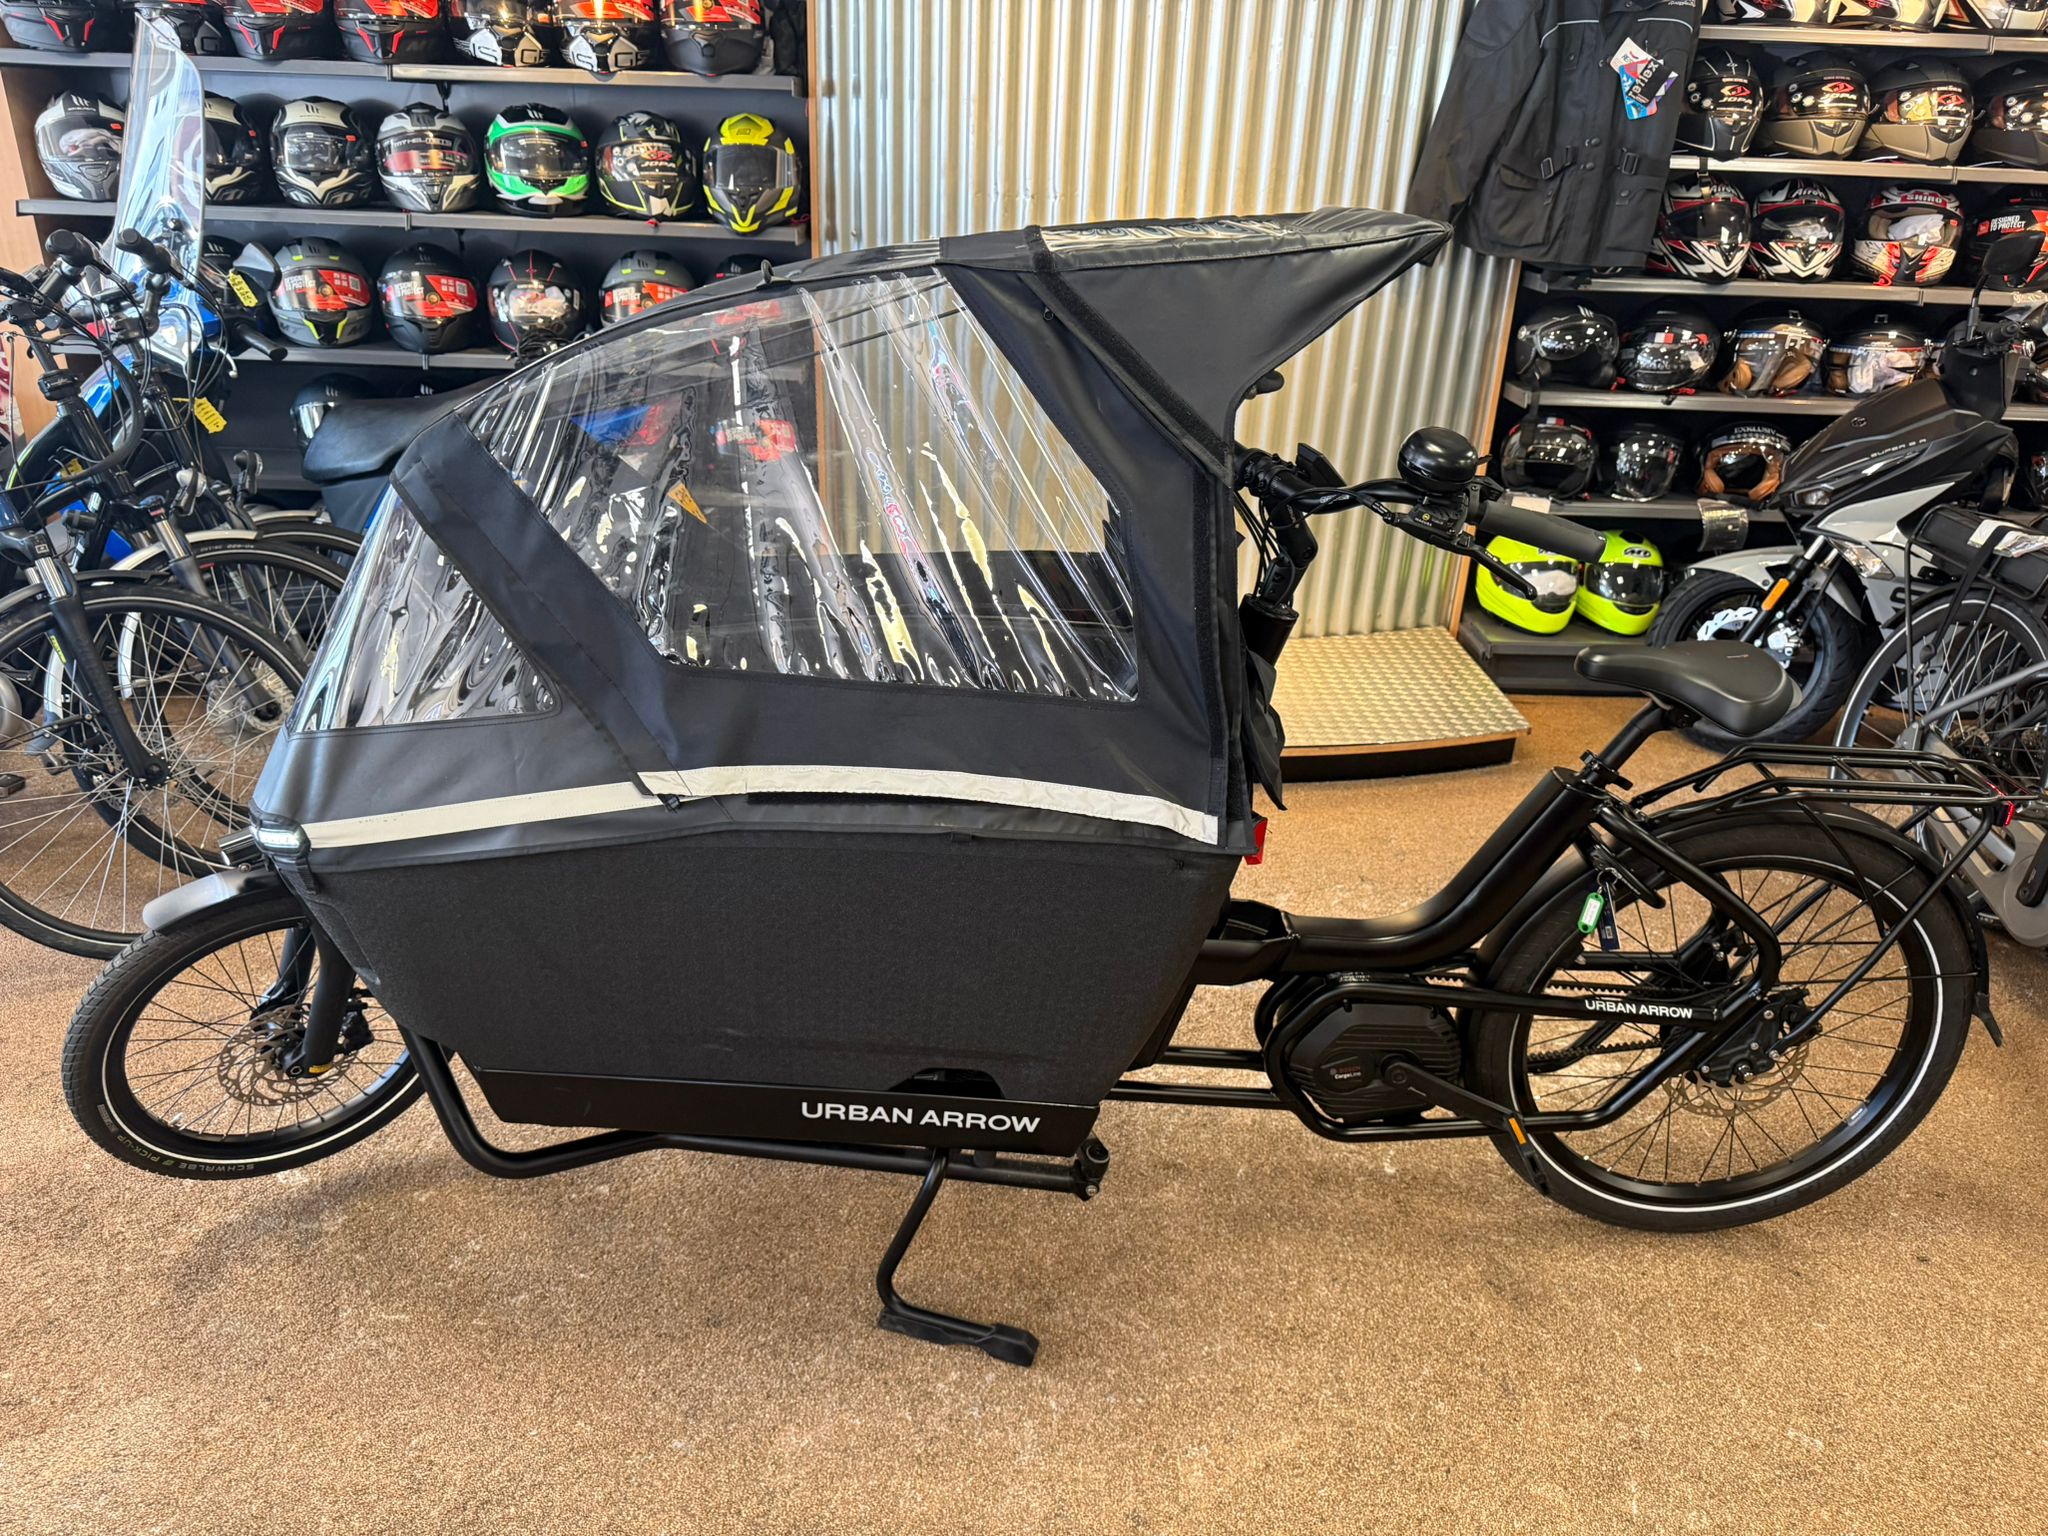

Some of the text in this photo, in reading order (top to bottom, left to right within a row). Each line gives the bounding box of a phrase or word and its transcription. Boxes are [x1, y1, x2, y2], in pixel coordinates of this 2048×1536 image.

[640, 161, 676, 169] JOPA
[1906, 194, 1944, 205] SHIRO
[1990, 215, 2021, 225] DESIGNED
[1998, 220, 2027, 231] PROTECT
[1585, 999, 1693, 1019] URBAN ARROW
[801, 1101, 1041, 1133] URBAN ARROW
[178, 1162, 256, 1173] SCHWALBE
